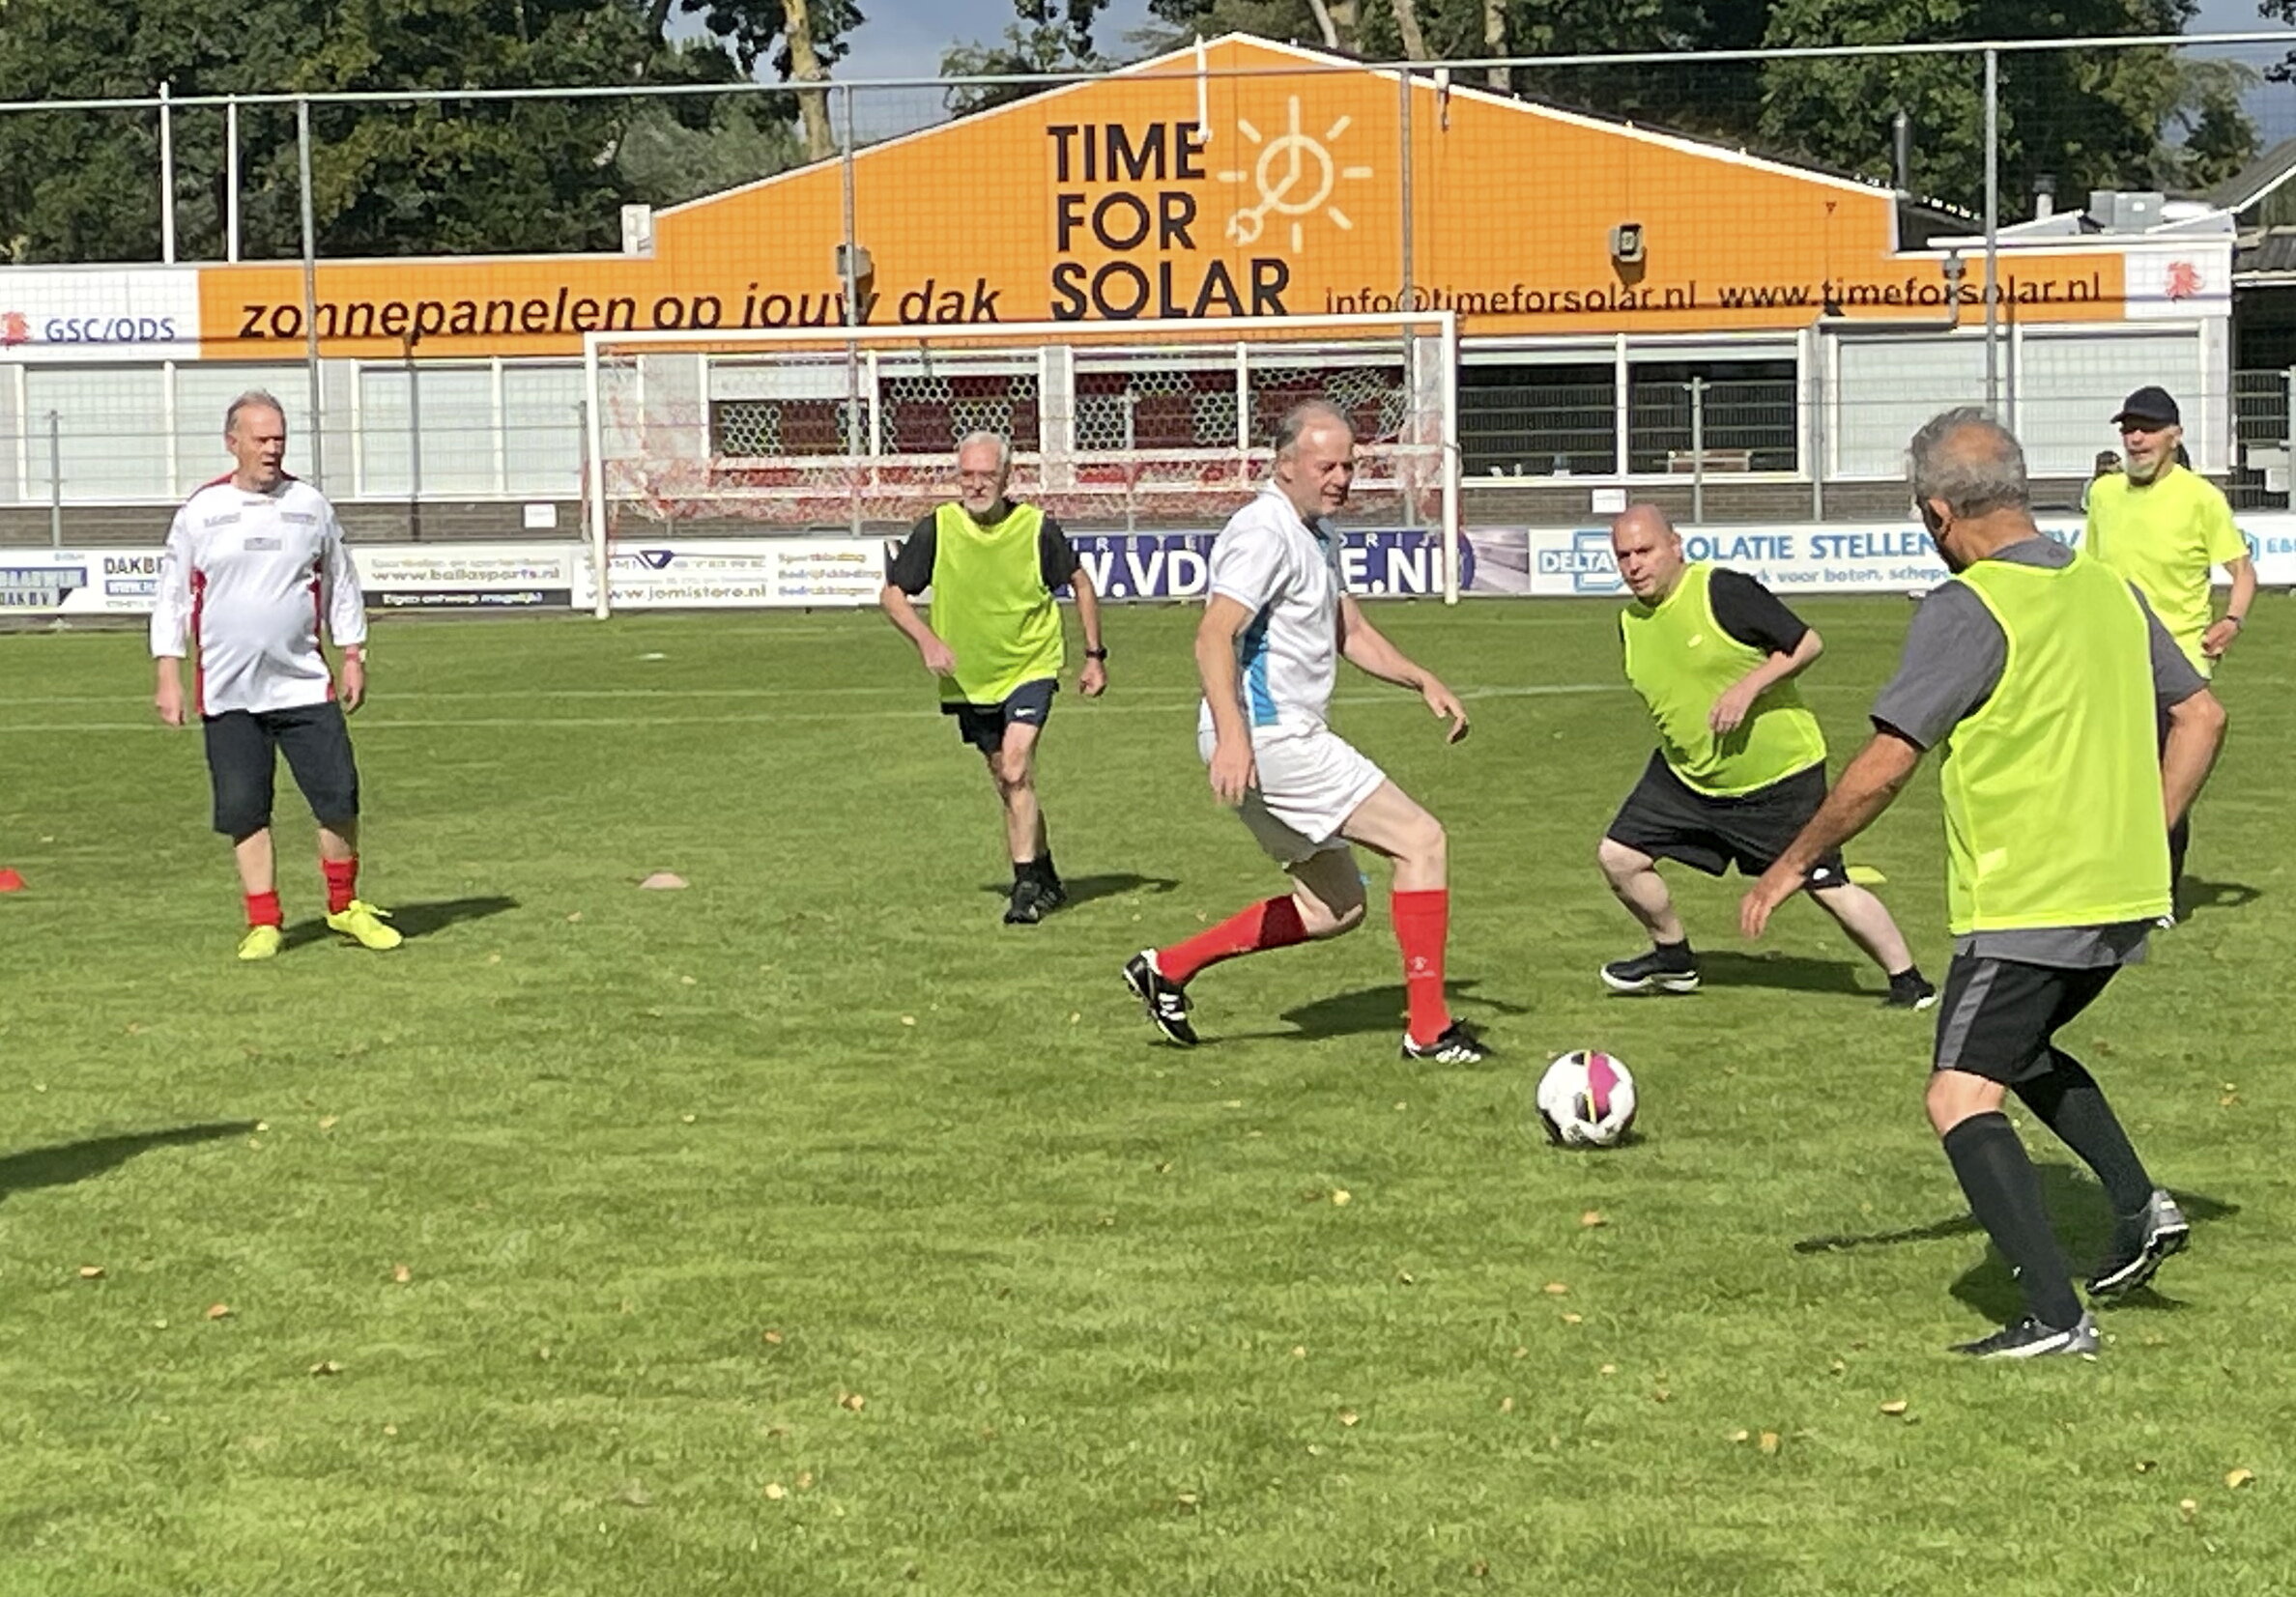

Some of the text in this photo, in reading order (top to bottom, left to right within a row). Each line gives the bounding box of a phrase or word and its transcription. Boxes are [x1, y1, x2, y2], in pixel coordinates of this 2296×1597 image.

[1047, 122, 1206, 183] TIME
[1057, 191, 1197, 251] FOR
[1050, 258, 1290, 321] SOLAR
[1326, 271, 2101, 315] info@timeforsolar.nl www.timeforsolar.nl
[45, 317, 176, 343] GSC/ODS
[240, 278, 1001, 346] zonnepanelen op jouw dak
[1540, 552, 1616, 572] DELTA
[1685, 534, 1794, 560] OLATIE
[1810, 532, 1938, 560] STELLEN
[1777, 570, 1820, 583] voor
